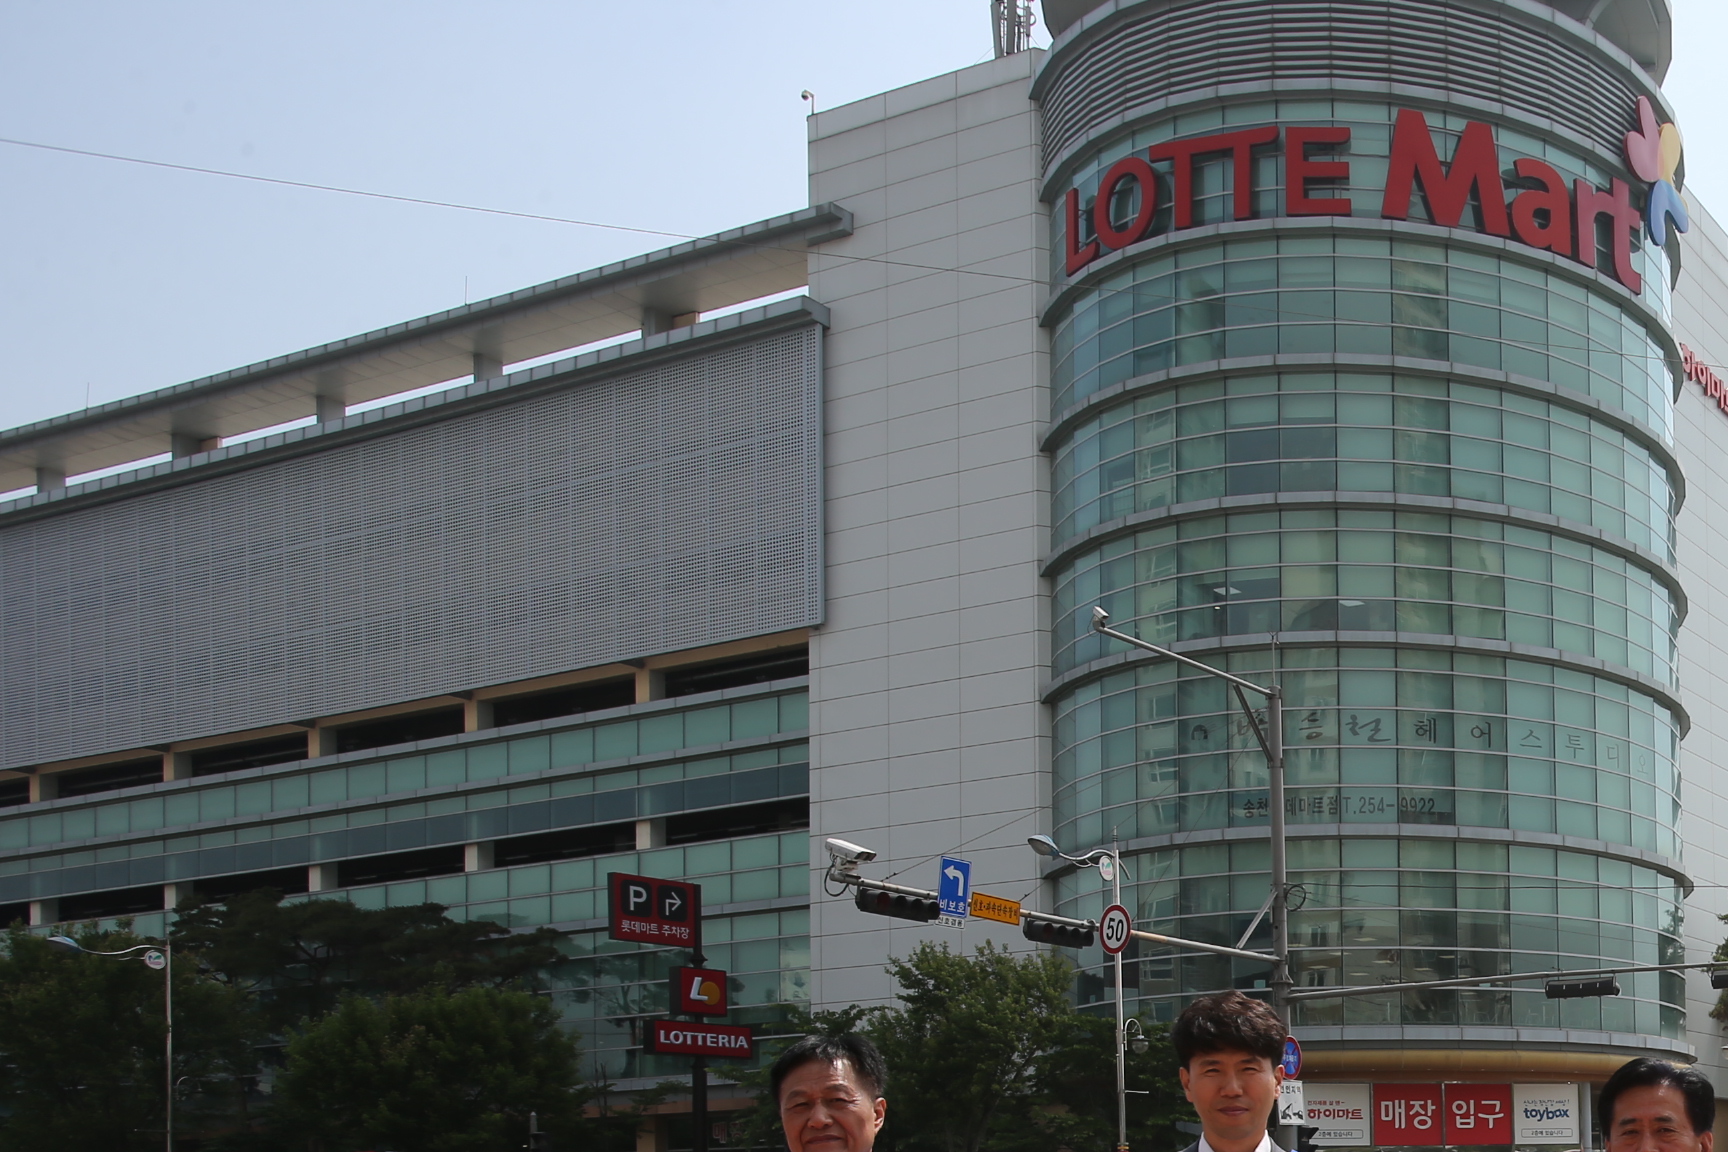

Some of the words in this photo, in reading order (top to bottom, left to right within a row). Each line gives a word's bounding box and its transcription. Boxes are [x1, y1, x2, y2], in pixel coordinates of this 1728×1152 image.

[1066, 125, 1351, 276] LOTTE
[1381, 107, 1643, 295] Mart
[629, 885, 647, 911] P
[939, 899, 965, 913] 비보호
[621, 919, 659, 935] 롯데마트
[661, 924, 690, 940] 주차장
[1106, 918, 1124, 942] 50
[659, 1029, 749, 1049] LOTTERIA
[1307, 1108, 1364, 1120] 하이마트
[1380, 1098, 1436, 1130] 매장
[1451, 1098, 1505, 1130] 입구
[1523, 1107, 1570, 1122] toybox
